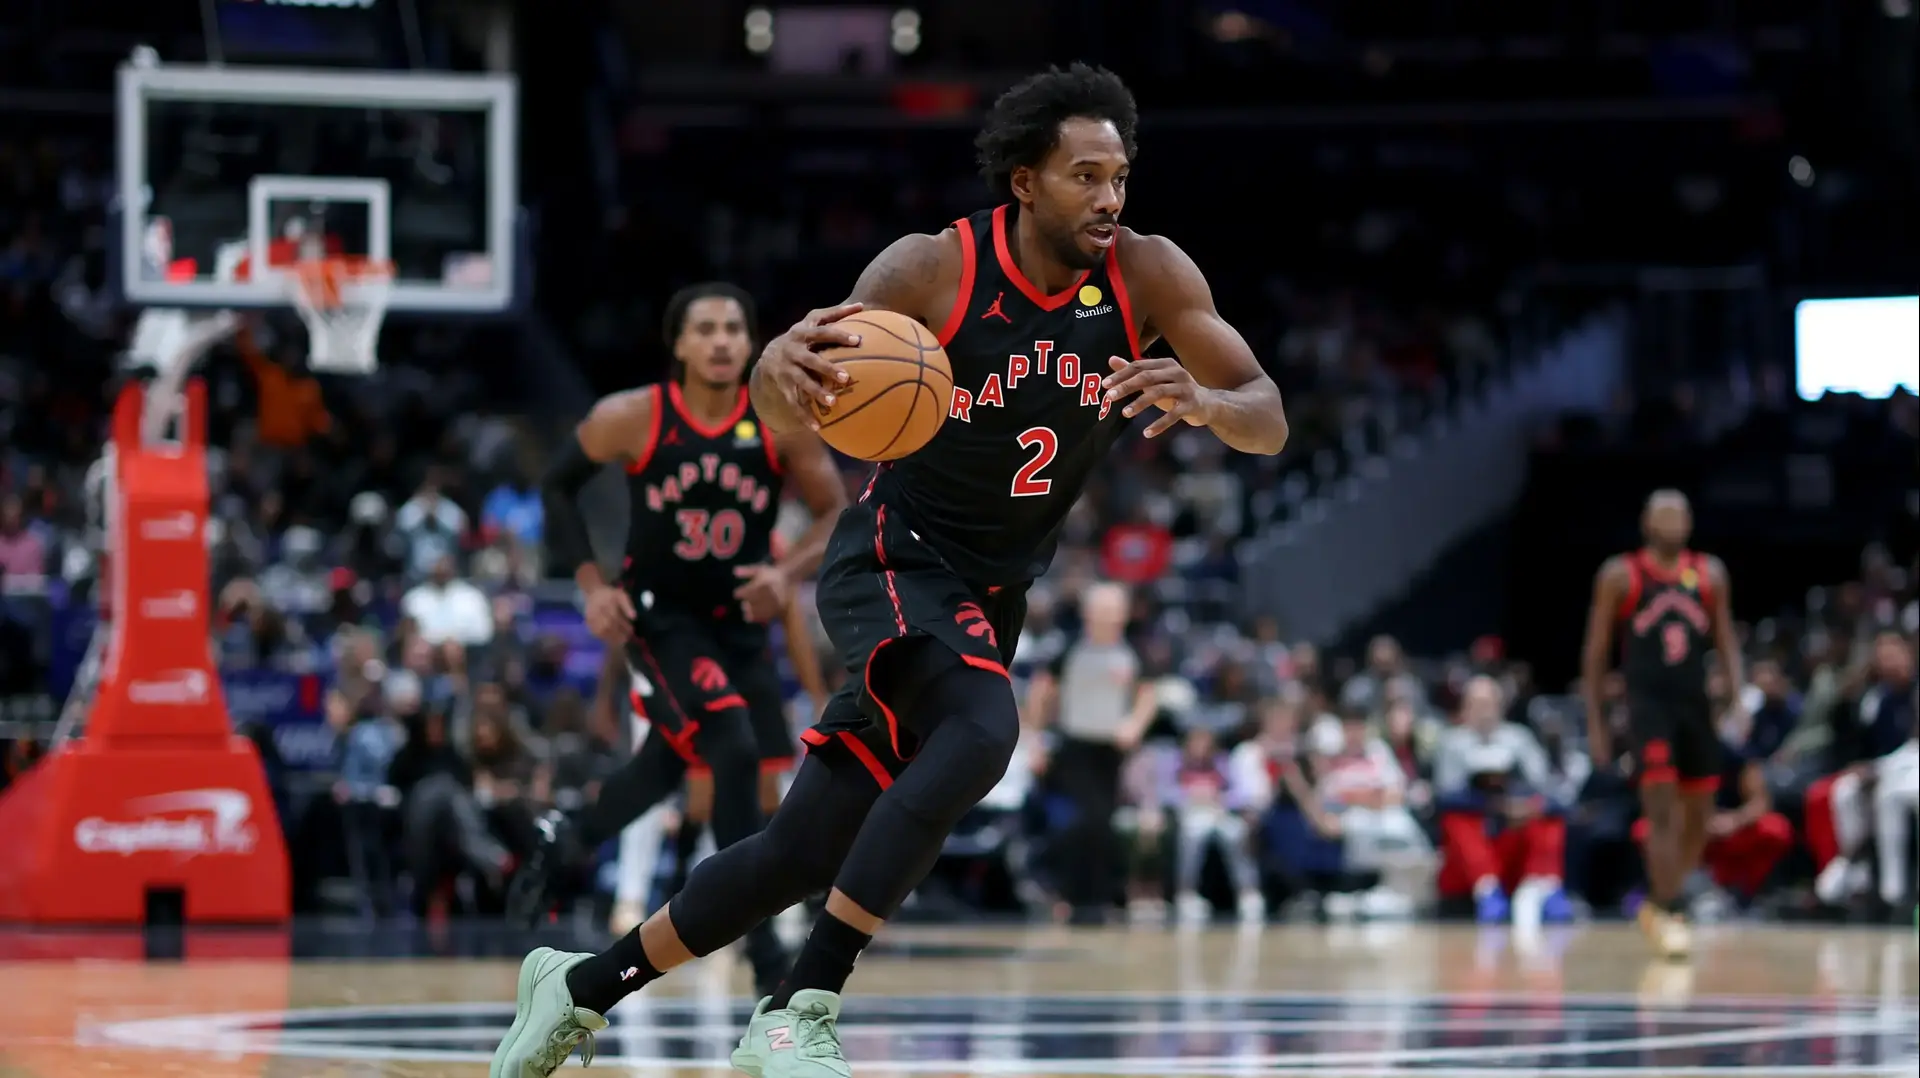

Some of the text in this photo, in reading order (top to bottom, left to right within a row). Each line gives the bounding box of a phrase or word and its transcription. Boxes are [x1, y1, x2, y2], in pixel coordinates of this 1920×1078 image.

[1075, 304, 1113, 319] Sunlife
[1010, 426, 1059, 497] 2
[673, 508, 746, 560] 30
